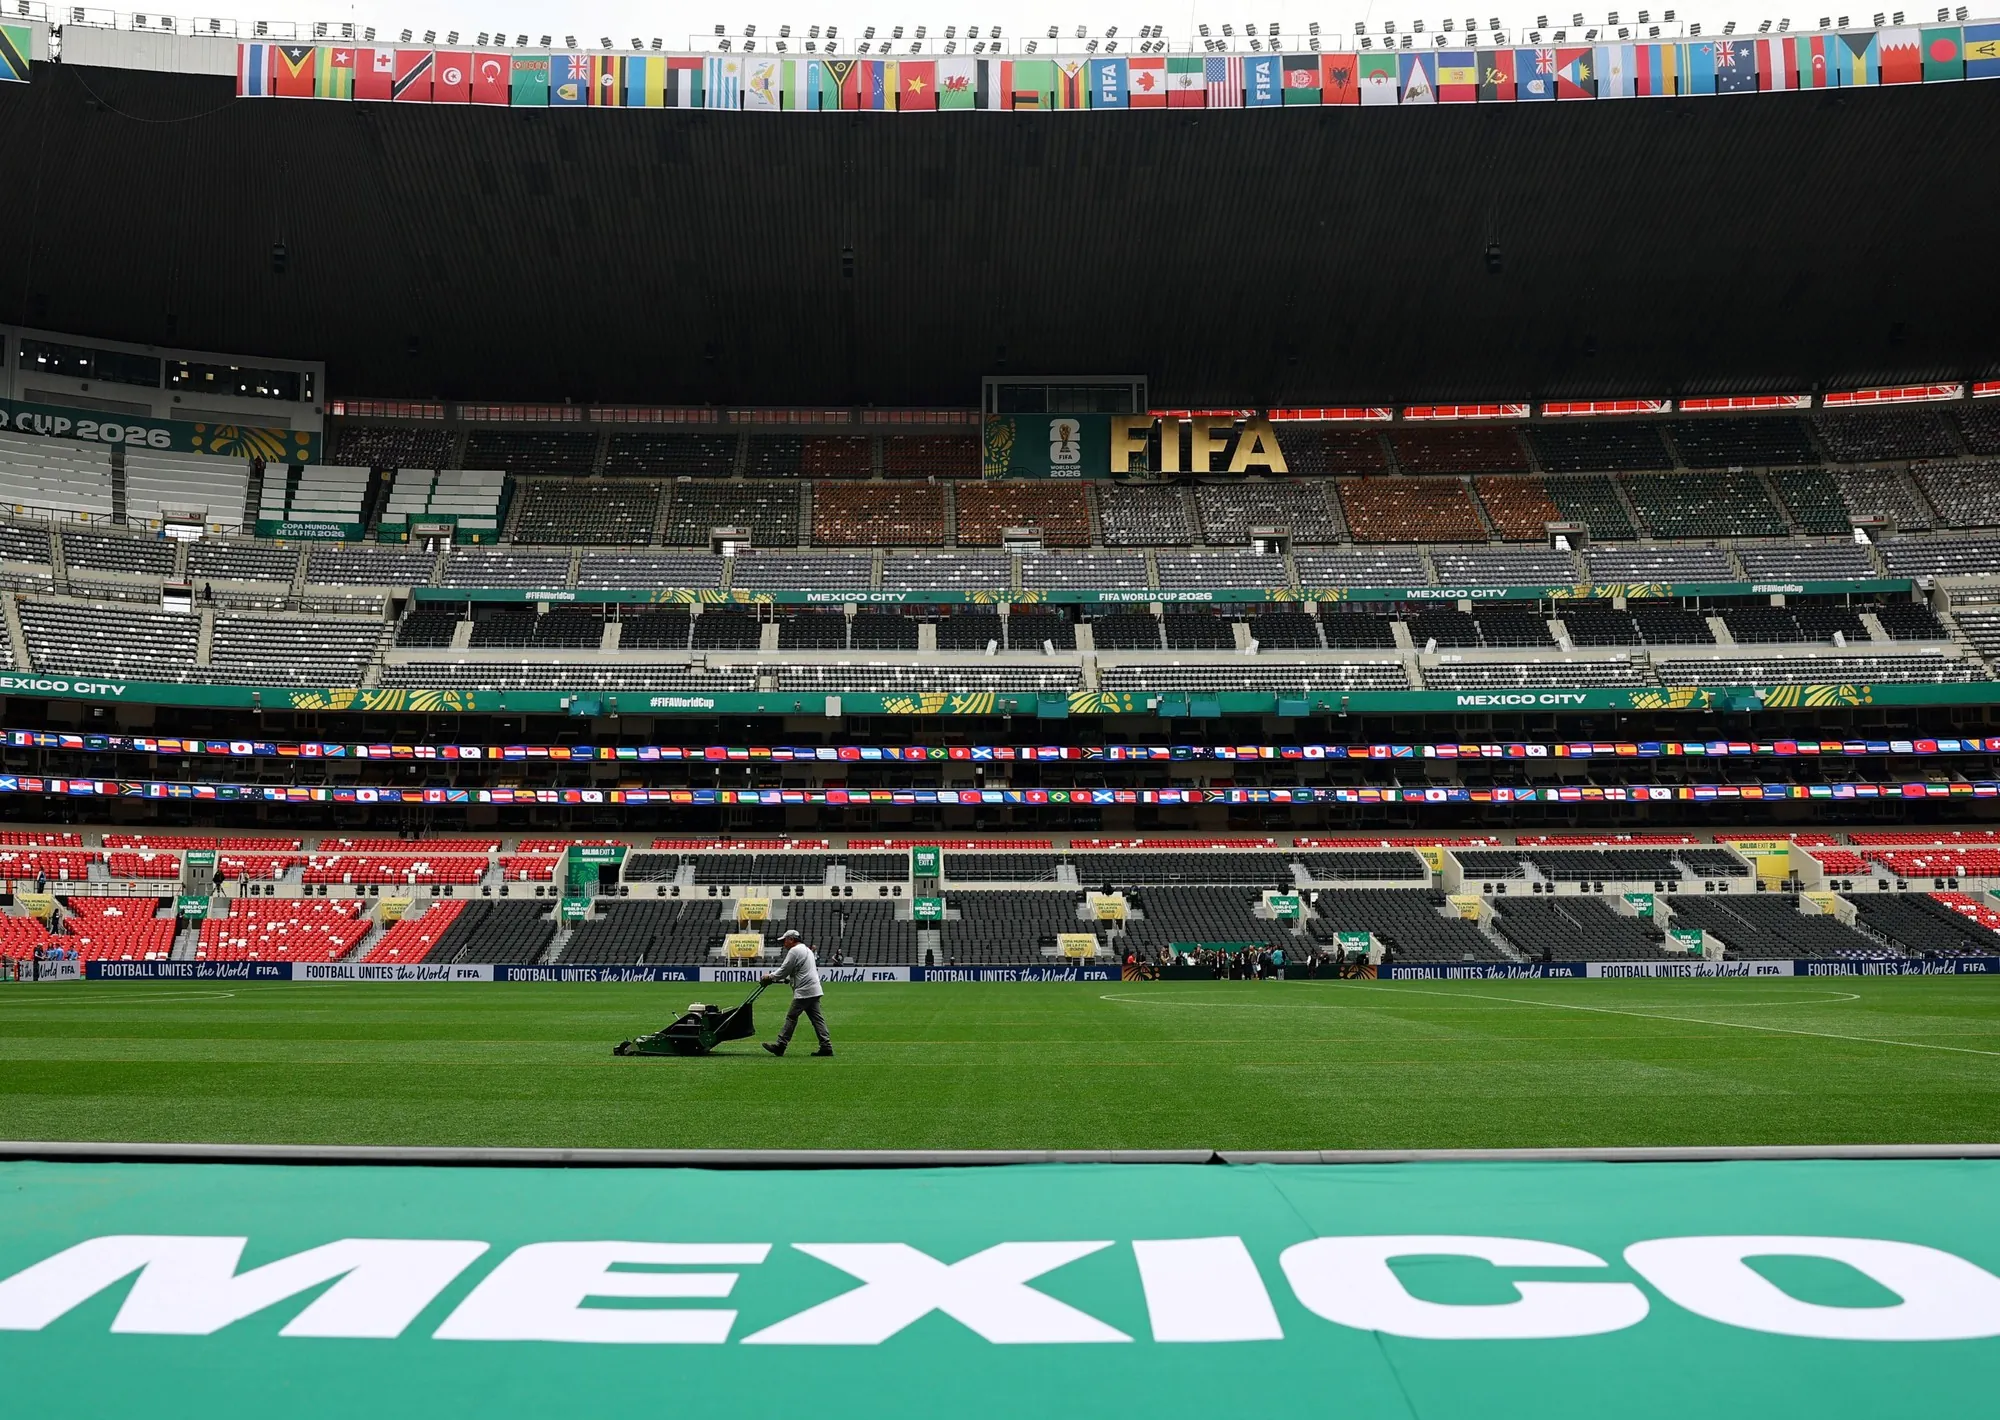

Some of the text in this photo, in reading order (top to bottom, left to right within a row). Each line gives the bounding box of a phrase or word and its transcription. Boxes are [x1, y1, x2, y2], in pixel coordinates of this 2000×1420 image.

[1102, 64, 1117, 102] FIFA
[1256, 62, 1271, 100] FIFA
[16, 412, 72, 434] CUP
[76, 420, 171, 448] 2026
[1110, 416, 1289, 473] FIFA
[1406, 589, 1507, 598] MEXICO CITY
[1752, 584, 1804, 593] #FIFAWorldCup
[525, 592, 575, 600] #FIFAWorldCup
[807, 593, 906, 601] MEXICO CITY
[1178, 592, 1212, 600] 2026
[74, 682, 126, 695] CITY
[650, 697, 714, 709] #FIFAWorldCup
[1457, 694, 1587, 705] MEXICO CITY
[61, 965, 75, 974] FIFA
[101, 962, 278, 978] FOOTBALL UNITES the World FIFA
[306, 966, 479, 981] FOOTBALL UNITES the World FIFA
[508, 968, 685, 982] FOOTBALL UNITES the World FIFA
[925, 968, 1107, 982] FOOTBALL UNITES the World FIFA
[1392, 965, 1572, 979] FOOTBALL UNITES the World FIFA
[1601, 962, 1779, 978] FOOTBALL UNITES the World FIFA
[1808, 960, 1986, 976] FOOTBALL UNITES the World FIFA
[830, 969, 865, 982] World
[872, 972, 894, 980] FIFA
[0, 1234, 2000, 1345] MEXICO
